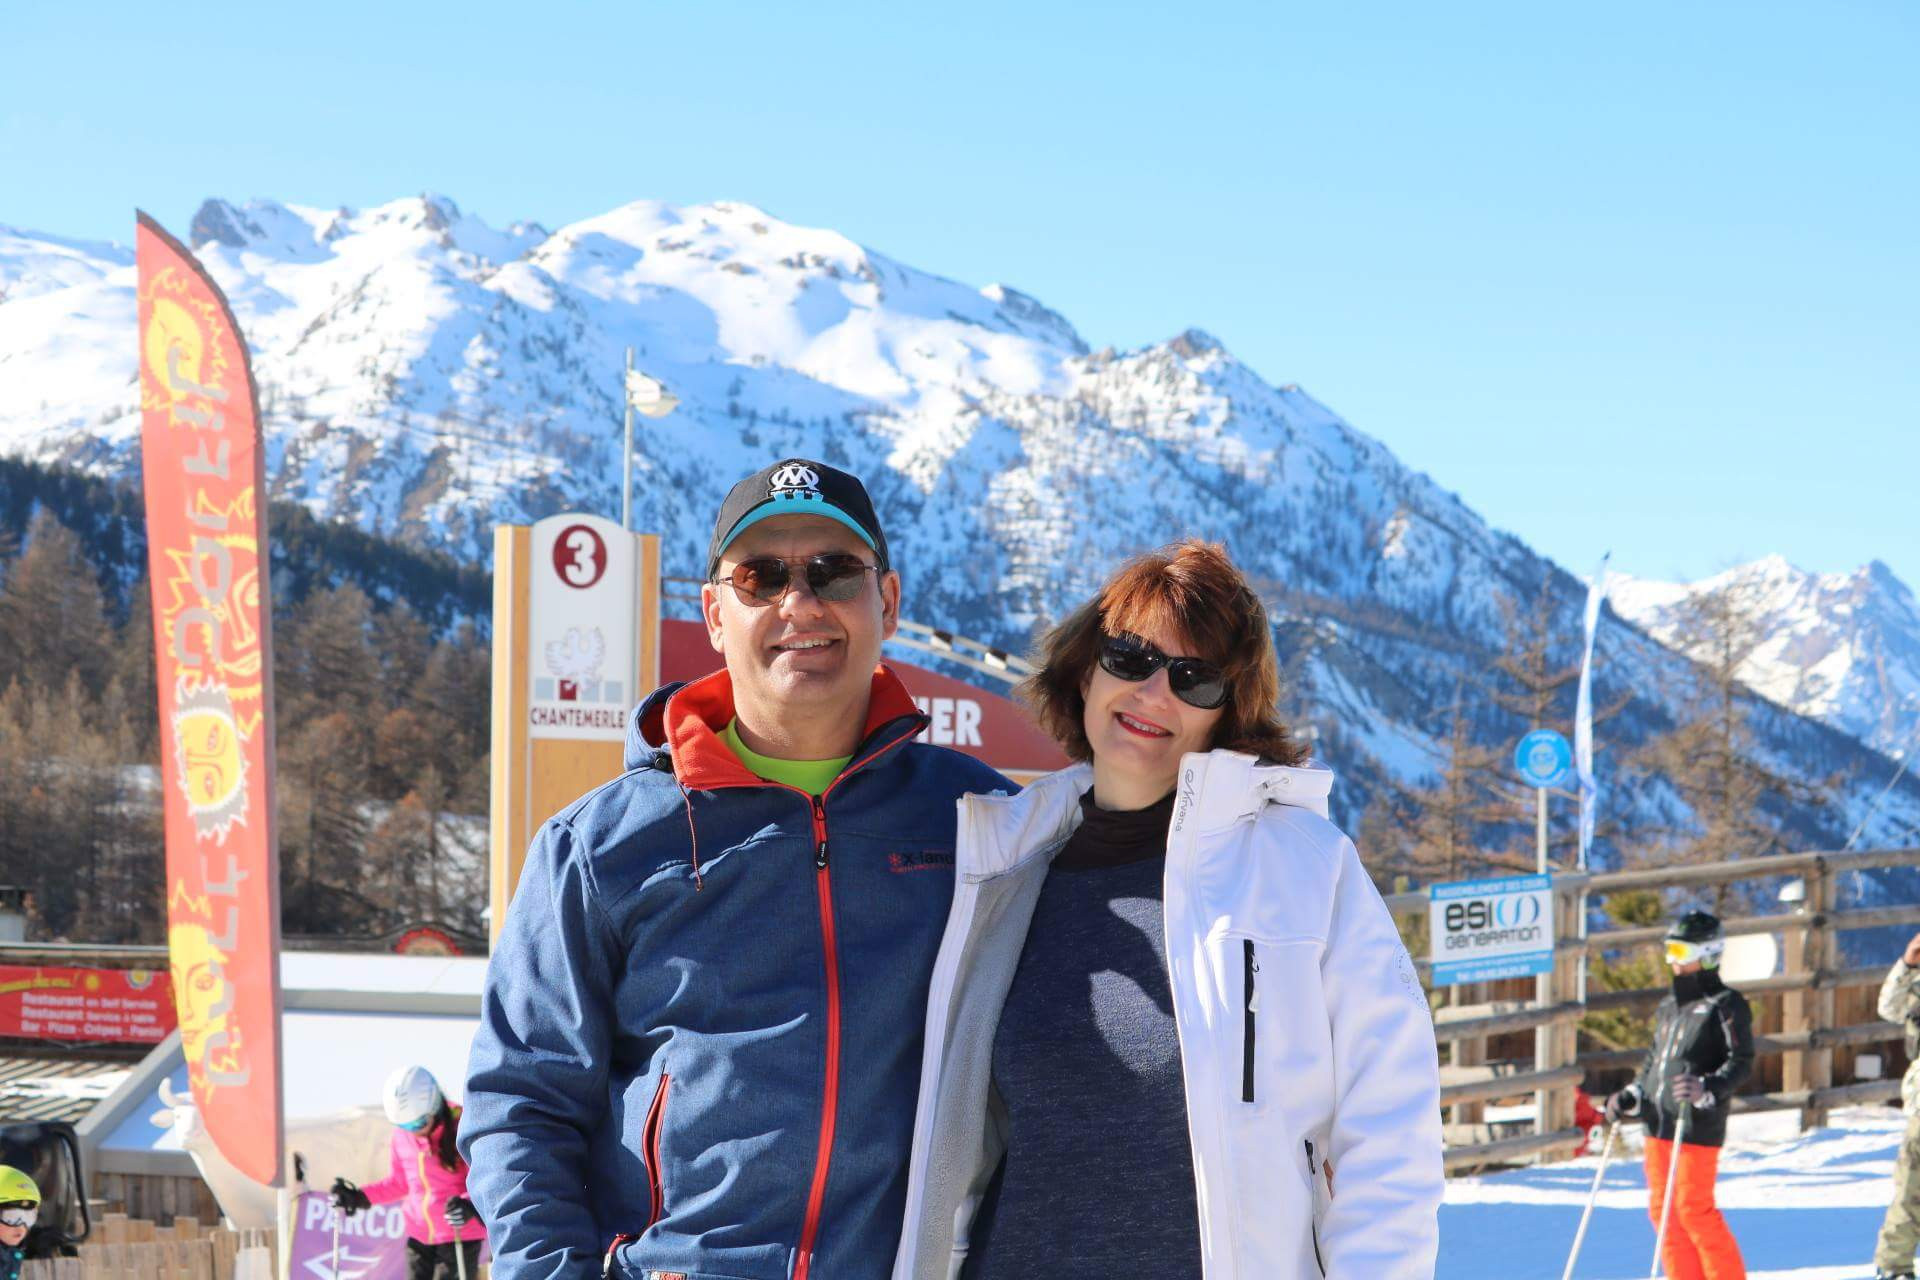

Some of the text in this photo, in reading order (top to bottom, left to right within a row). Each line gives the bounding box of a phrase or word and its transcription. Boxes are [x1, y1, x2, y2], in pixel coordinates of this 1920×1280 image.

[565, 529, 597, 586] 3
[530, 706, 625, 729] CHANTEMERLE
[22, 992, 84, 1007] Restaurant
[22, 1006, 84, 1021] Restaurant
